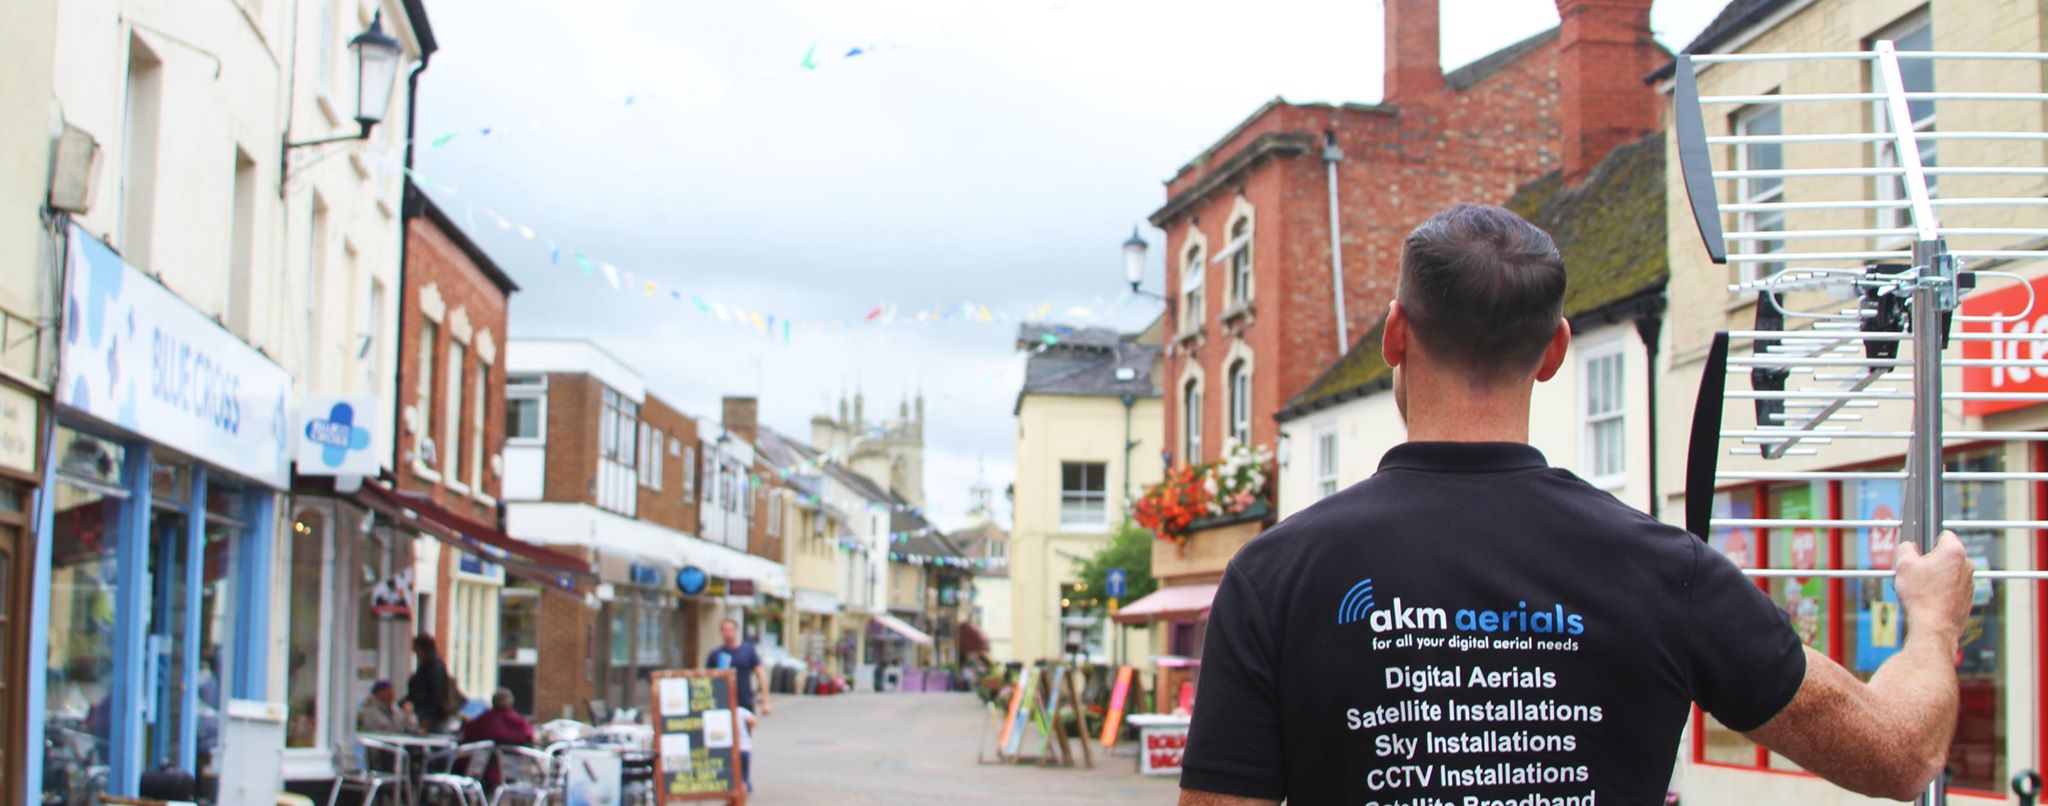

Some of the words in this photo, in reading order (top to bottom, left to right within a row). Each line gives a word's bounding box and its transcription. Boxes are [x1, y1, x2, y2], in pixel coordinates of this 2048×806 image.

[153, 326, 190, 412] BLUE
[193, 352, 241, 435] CROSS
[1370, 597, 1447, 632] akm
[1455, 601, 1585, 635] aerials
[1372, 636, 1392, 651] for
[1396, 634, 1413, 648] all
[1416, 637, 1445, 651] your
[1449, 635, 1489, 652] digital
[1493, 637, 1533, 650] aerial
[1537, 638, 1579, 651] needs
[1385, 665, 1461, 693] Digital
[1468, 666, 1556, 688] Aerials
[1346, 700, 1442, 730] Satellite
[1449, 700, 1603, 722] Installations
[1375, 733, 1418, 760] Sky
[1427, 731, 1577, 754] Installations
[1367, 765, 1434, 791] CCTV
[1440, 763, 1589, 787] Installations
